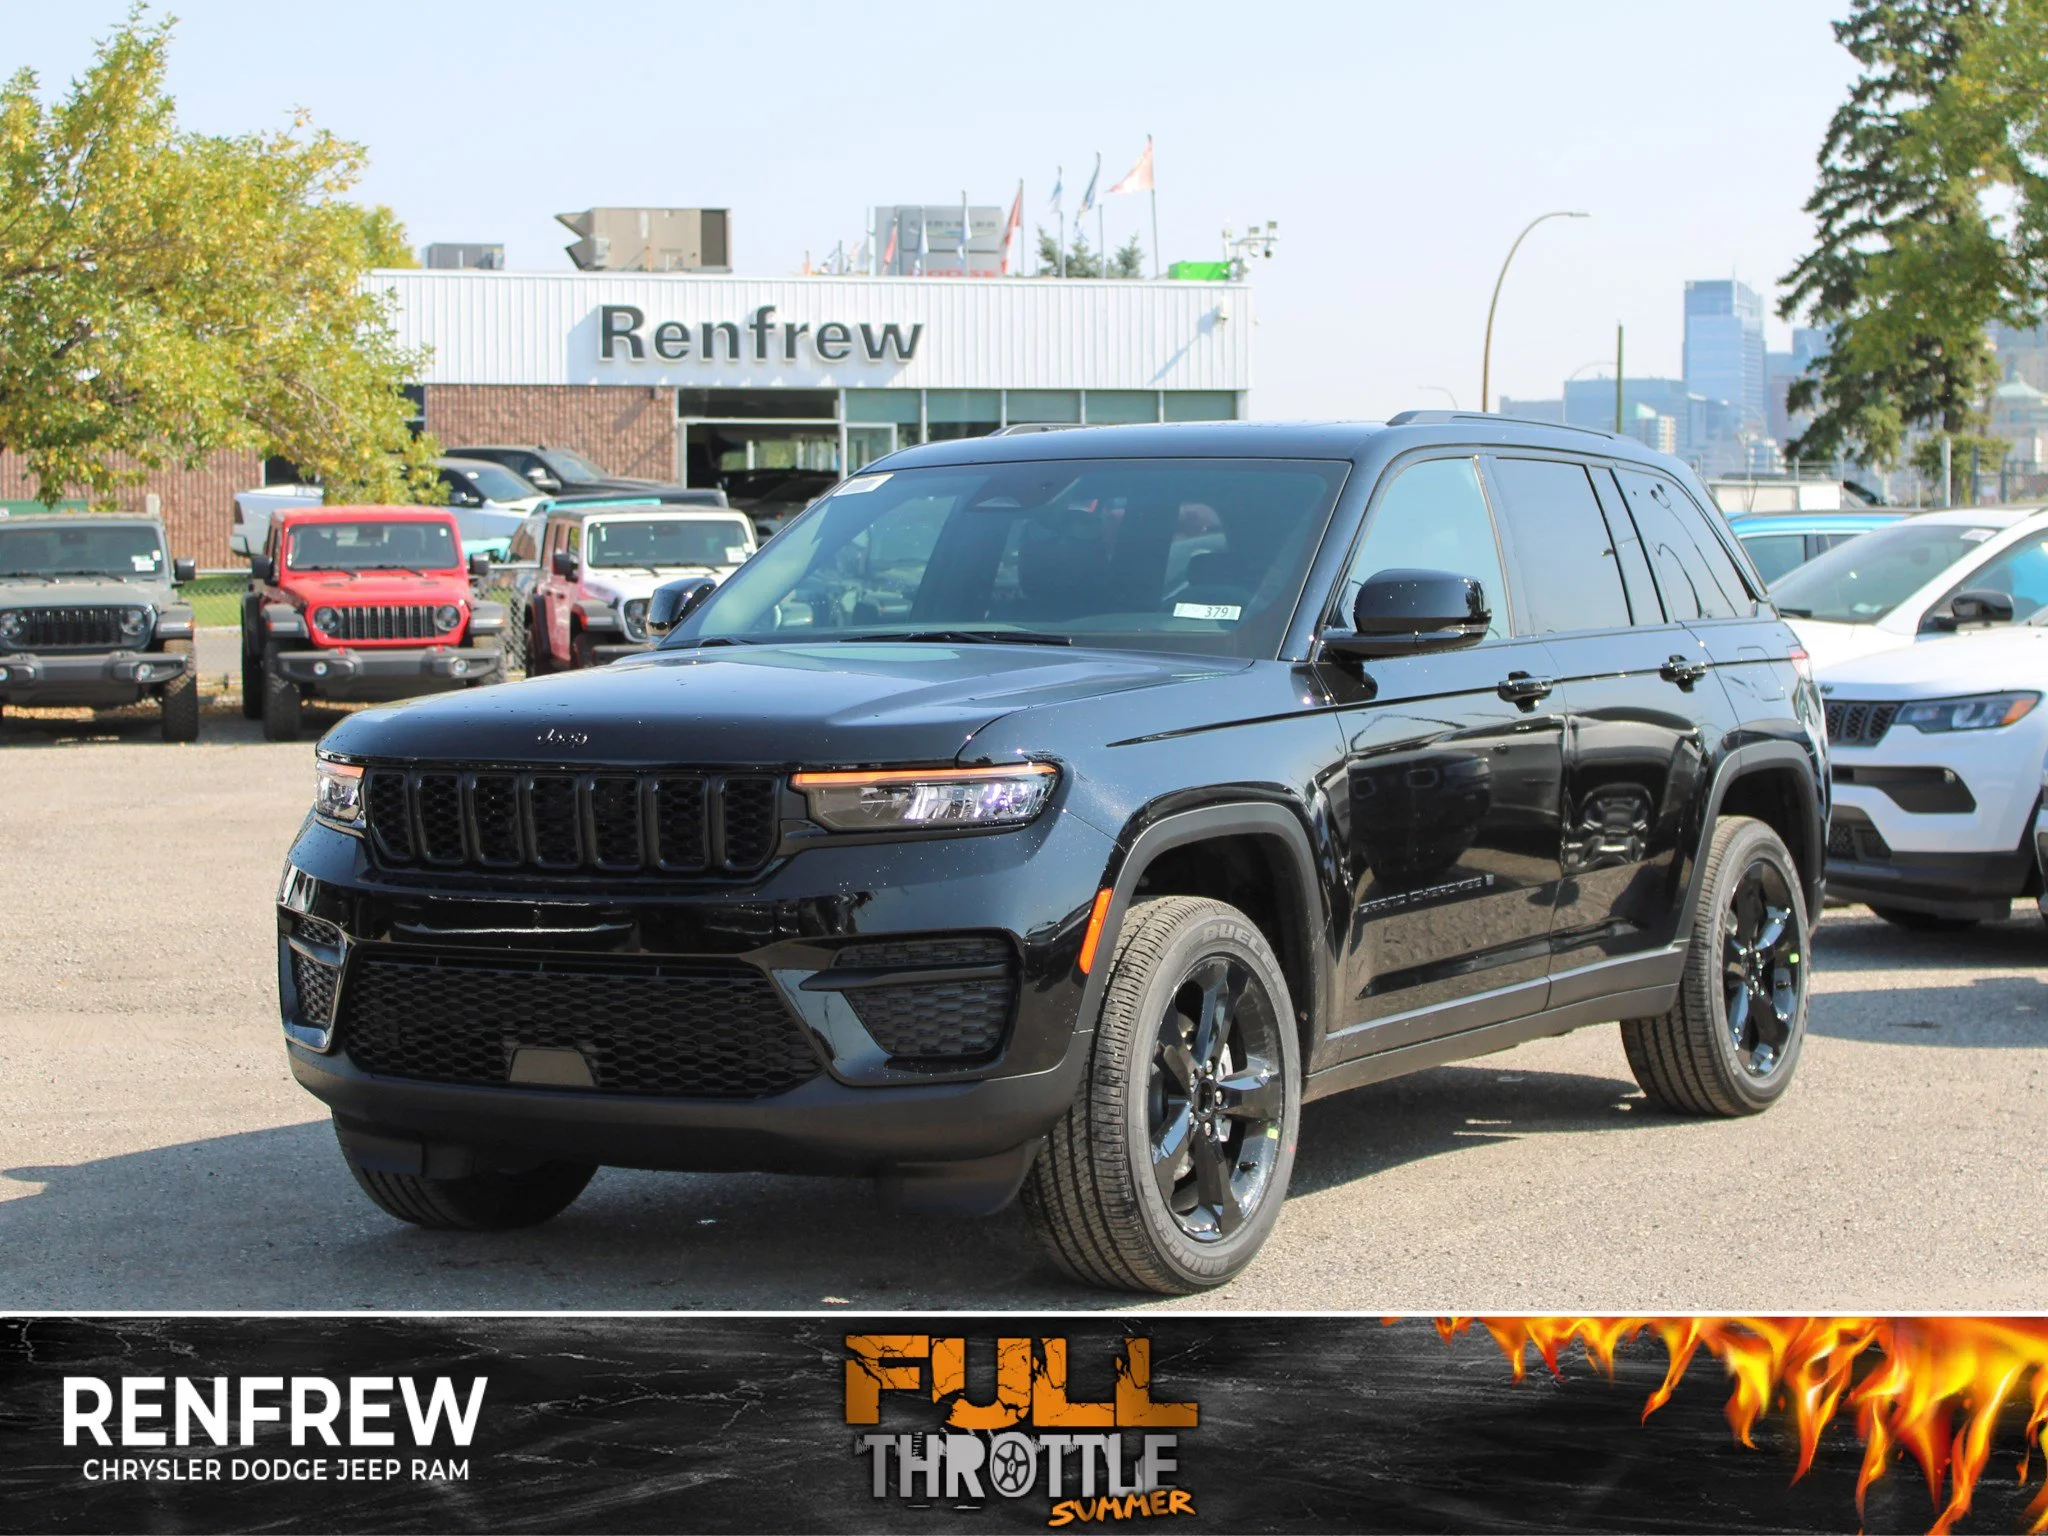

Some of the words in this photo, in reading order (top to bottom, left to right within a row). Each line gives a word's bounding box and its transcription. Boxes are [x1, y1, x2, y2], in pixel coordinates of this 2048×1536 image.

[909, 219, 997, 228] CHRYSER
[599, 304, 924, 362] Renfrew
[1204, 606, 1229, 618] 379
[1202, 923, 1286, 998] DUELER
